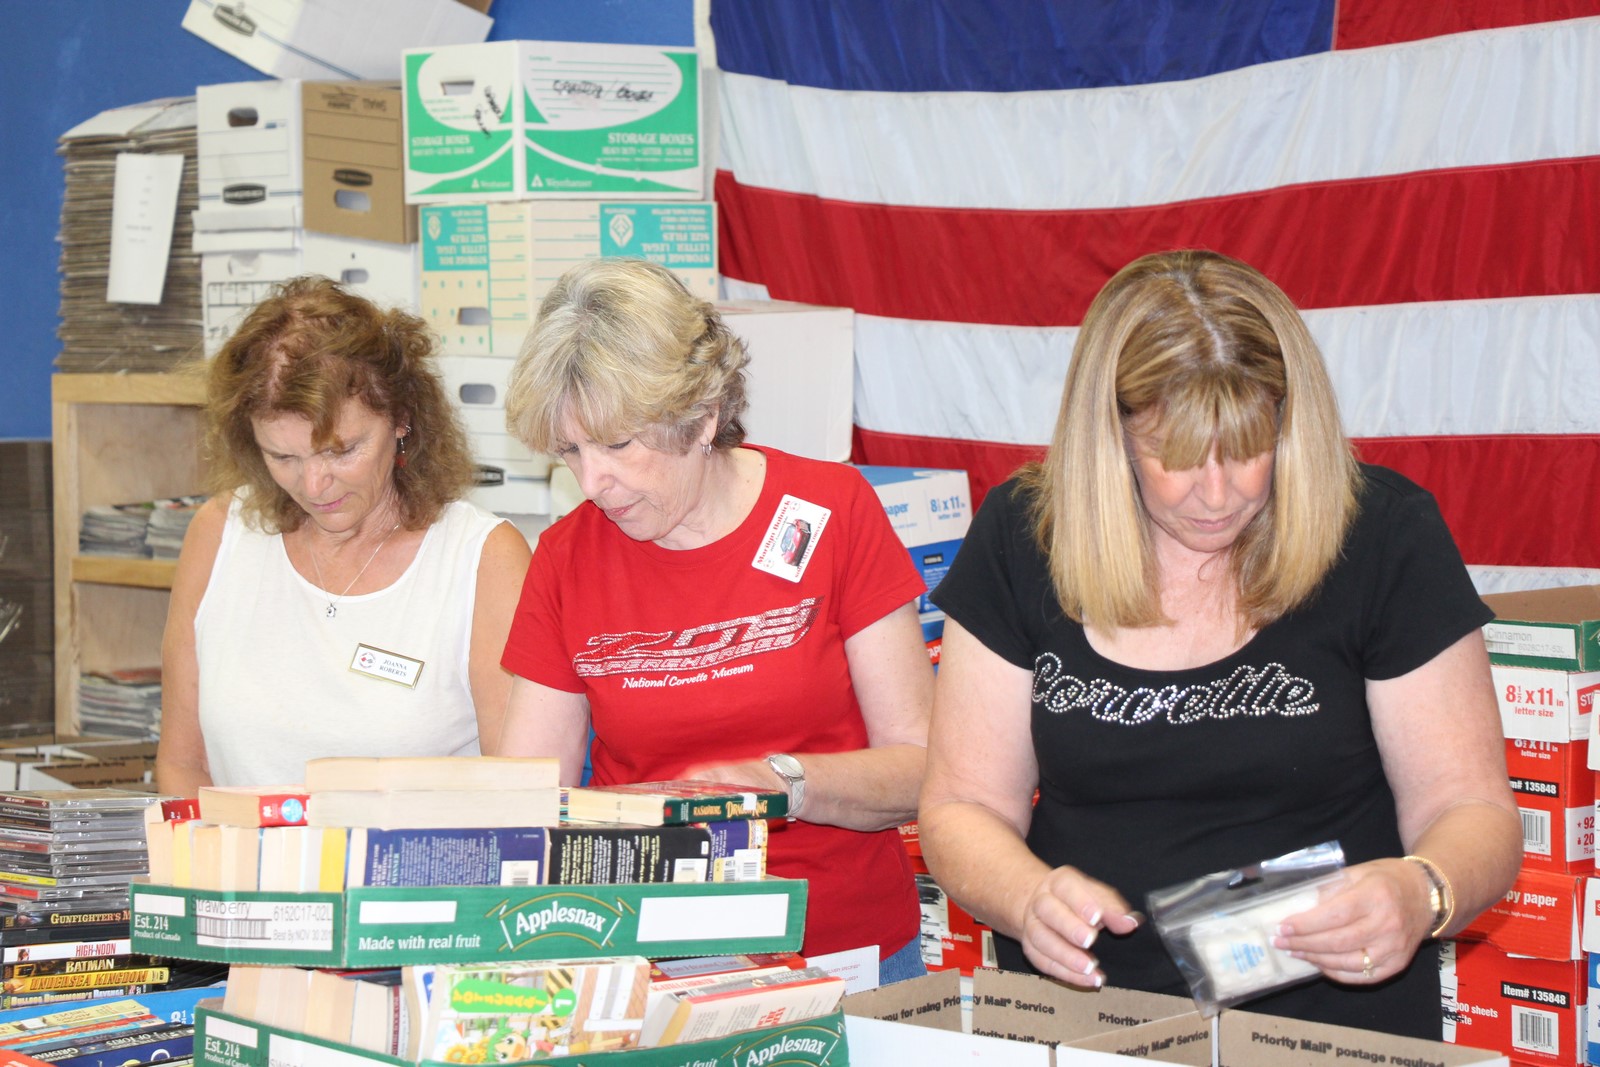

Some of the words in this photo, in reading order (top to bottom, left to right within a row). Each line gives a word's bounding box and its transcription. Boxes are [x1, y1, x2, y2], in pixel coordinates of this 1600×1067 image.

[608, 132, 656, 145] STORAGE
[660, 134, 694, 146] BOXES
[669, 254, 710, 263] STORAGE
[943, 500, 950, 511] x
[950, 496, 960, 510] 11
[1487, 627, 1533, 642] Cinnamon
[379, 665, 407, 677] ROBERTS
[383, 659, 408, 671] JOANNA
[622, 674, 670, 689] National
[668, 673, 708, 687] Corvette
[711, 664, 754, 680] Museum
[1032, 652, 1320, 725] Corvette
[1525, 690, 1535, 704] x
[1537, 687, 1554, 706] 11
[1514, 706, 1536, 716] letter
[1538, 708, 1554, 718] size
[1521, 749, 1537, 758] letter
[1538, 751, 1551, 760] size
[1524, 781, 1557, 795] 135848
[191, 895, 251, 918] Strawberry
[1502, 890, 1521, 904] py
[1523, 892, 1558, 908] paper
[50, 910, 122, 925] GUNFIGHTER'S
[134, 914, 152, 929] Est.
[153, 916, 169, 931] 214
[515, 901, 607, 935] Applesnax
[134, 930, 154, 940] Product
[154, 932, 161, 940] of
[160, 932, 181, 942] Canada
[358, 936, 395, 950] Made
[397, 936, 426, 950] with
[428, 935, 452, 949] real
[454, 934, 481, 949] fruit
[76, 944, 94, 957] HIGH
[95, 943, 117, 956] NOON
[66, 958, 115, 973] BATMAN
[30, 974, 91, 990] UNDERSEA
[94, 970, 148, 985] KINGDOM
[10, 996, 43, 1007] BULLDOG
[1531, 989, 1566, 1005] 135848
[900, 1007, 914, 1019] for
[916, 1001, 941, 1016] using
[1015, 1000, 1056, 1015] Service
[1471, 1005, 1498, 1018] sheets
[1098, 1012, 1140, 1027] Priority
[972, 1028, 1005, 1039] riority
[1176, 1030, 1209, 1045] Service
[205, 1036, 223, 1054] Est.
[224, 1041, 240, 1059] 214
[745, 1034, 826, 1067] Applesnax
[1251, 1031, 1297, 1050] Priority
[1335, 1046, 1386, 1063] postage
[204, 1052, 225, 1064] Product
[225, 1058, 231, 1066] of
